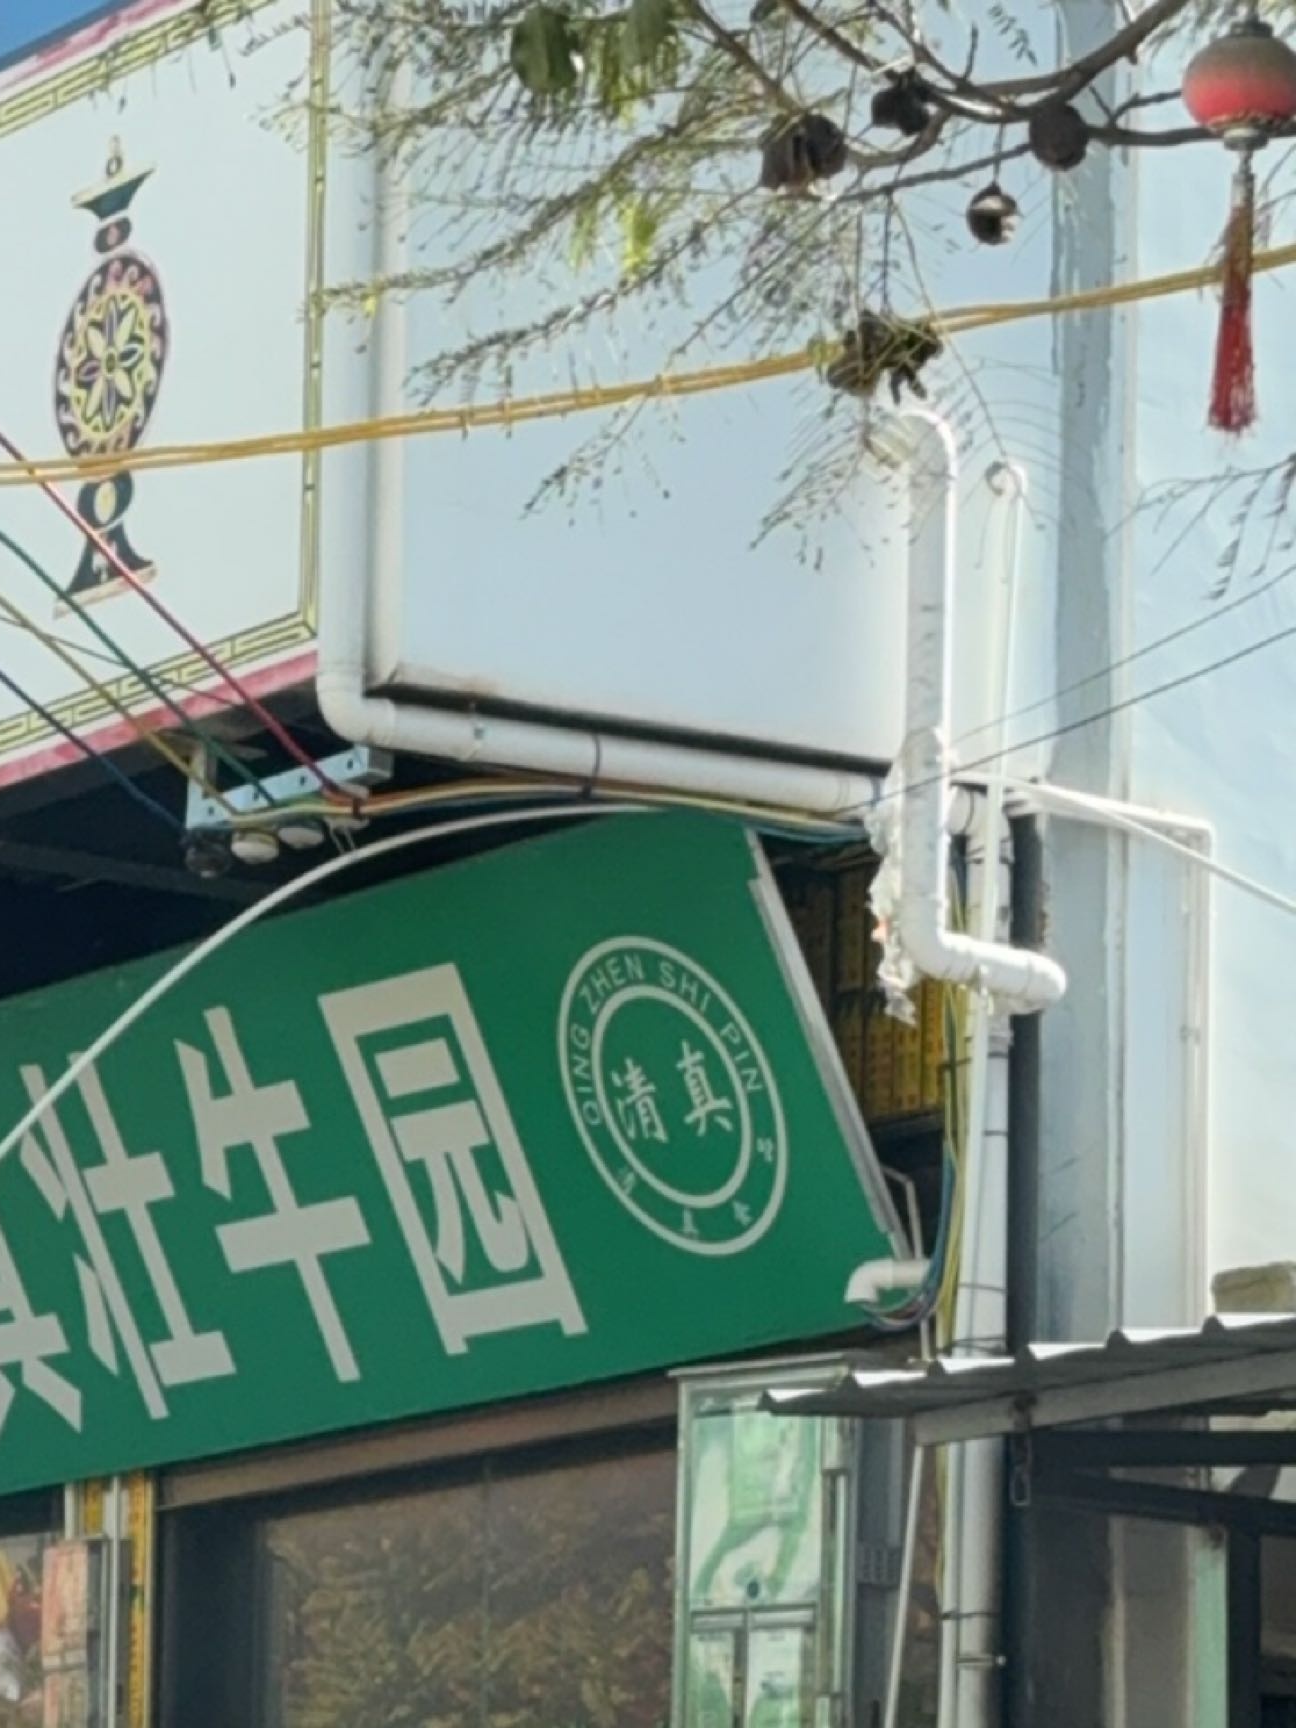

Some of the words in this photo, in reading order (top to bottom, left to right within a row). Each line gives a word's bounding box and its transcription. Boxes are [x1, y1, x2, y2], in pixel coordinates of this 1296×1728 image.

[577, 954, 647, 1017] ZHEN
[658, 962, 711, 1014] SHI
[718, 1020, 765, 1094] PIN
[610, 1037, 735, 1144] 清真
